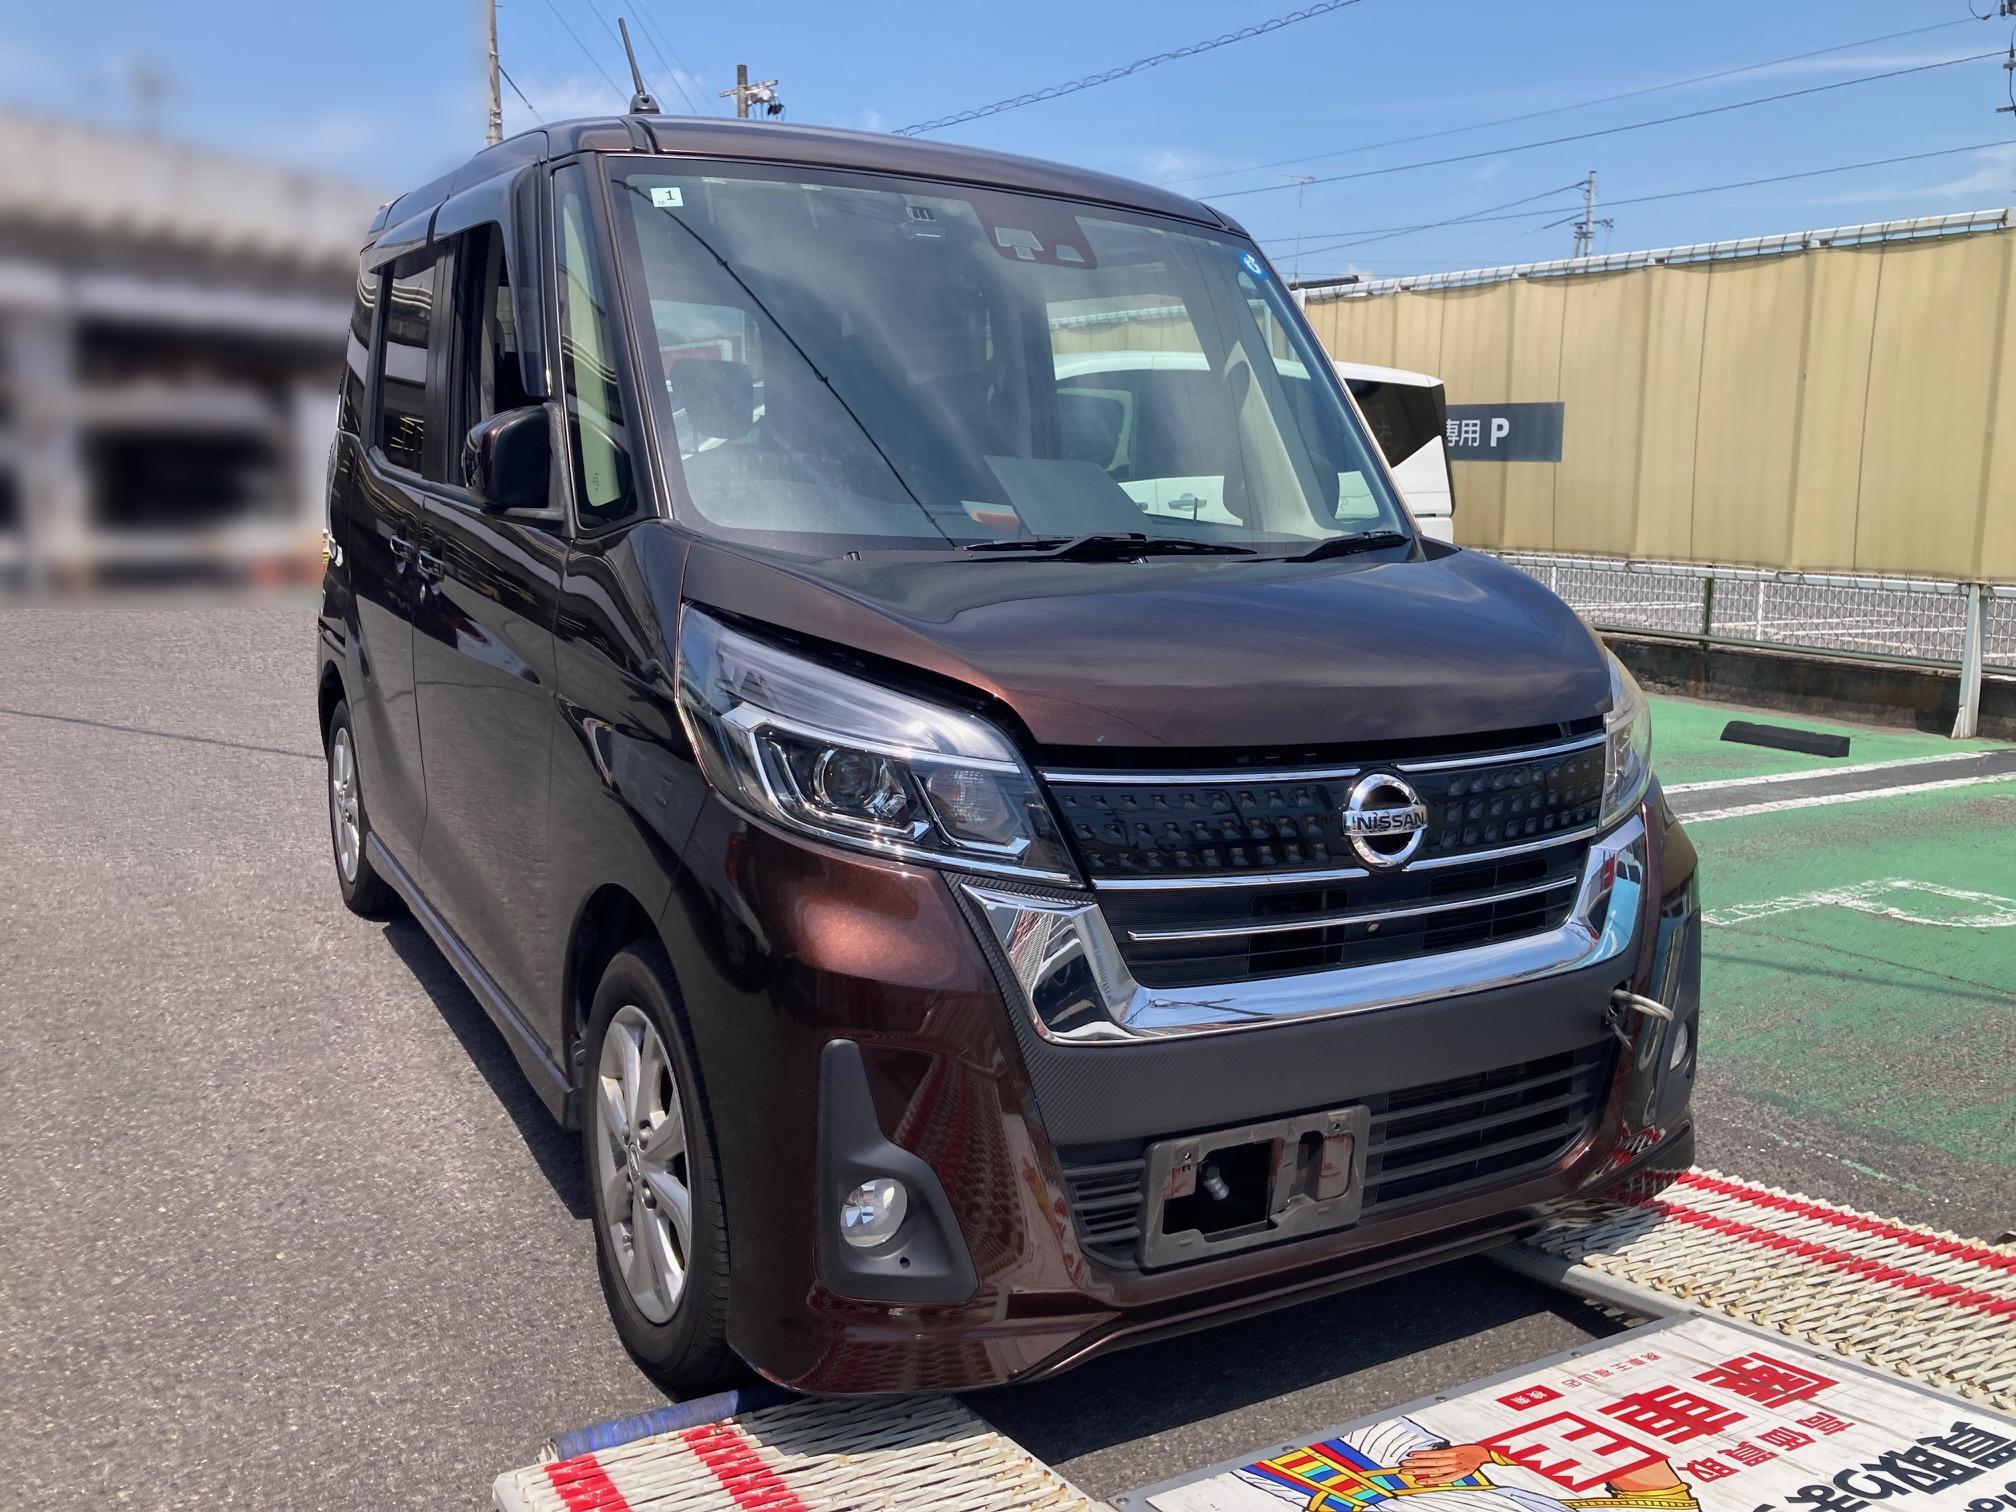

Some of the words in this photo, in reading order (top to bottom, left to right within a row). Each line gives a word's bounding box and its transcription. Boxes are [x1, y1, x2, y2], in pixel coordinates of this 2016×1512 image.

[665, 190, 675, 200] 1
[1490, 417, 1510, 447] P
[1356, 811, 1425, 831] NISSAN
[1675, 1410, 1857, 1483] 高価買取
[1752, 1421, 2016, 1512] 買取りま
